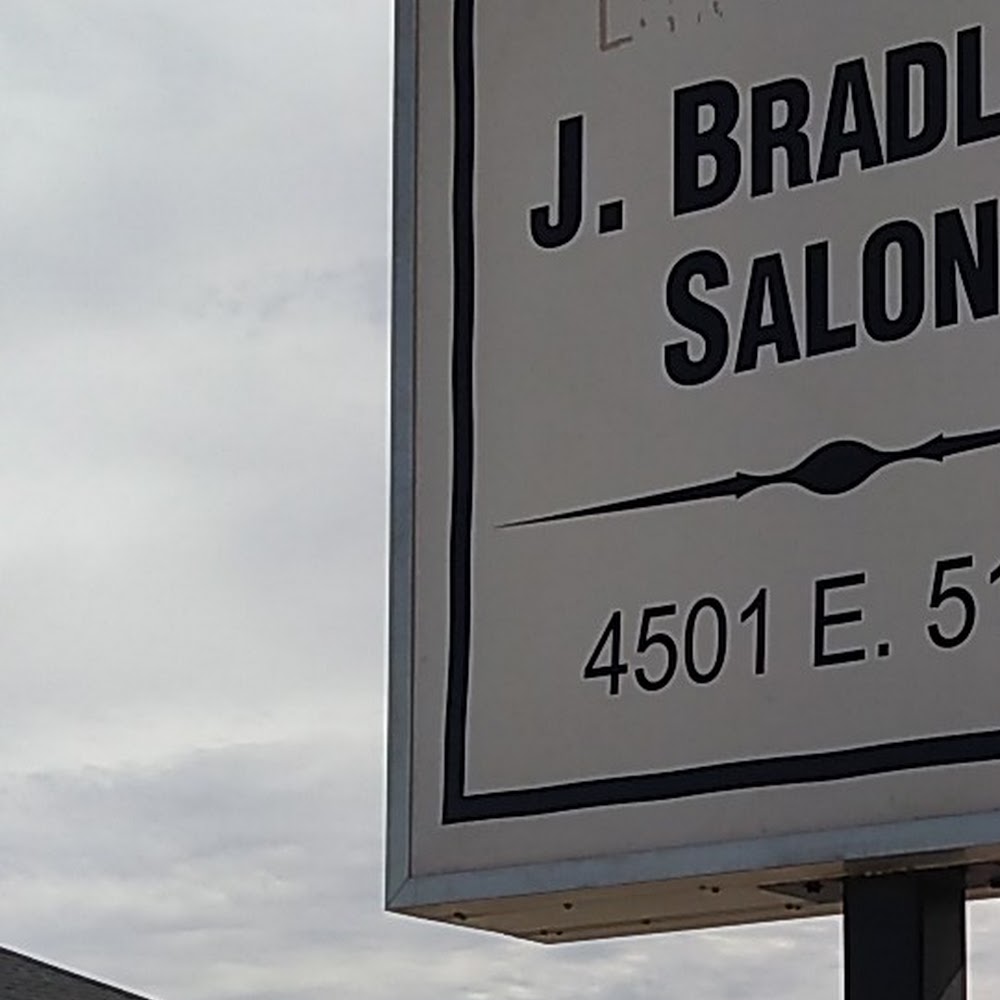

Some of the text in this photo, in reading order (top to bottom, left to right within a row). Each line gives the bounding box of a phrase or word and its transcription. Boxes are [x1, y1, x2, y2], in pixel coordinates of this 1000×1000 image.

[530, 114, 624, 249] J.
[664, 198, 999, 386] SALON
[583, 587, 767, 696] 4501
[813, 572, 890, 668] E.
